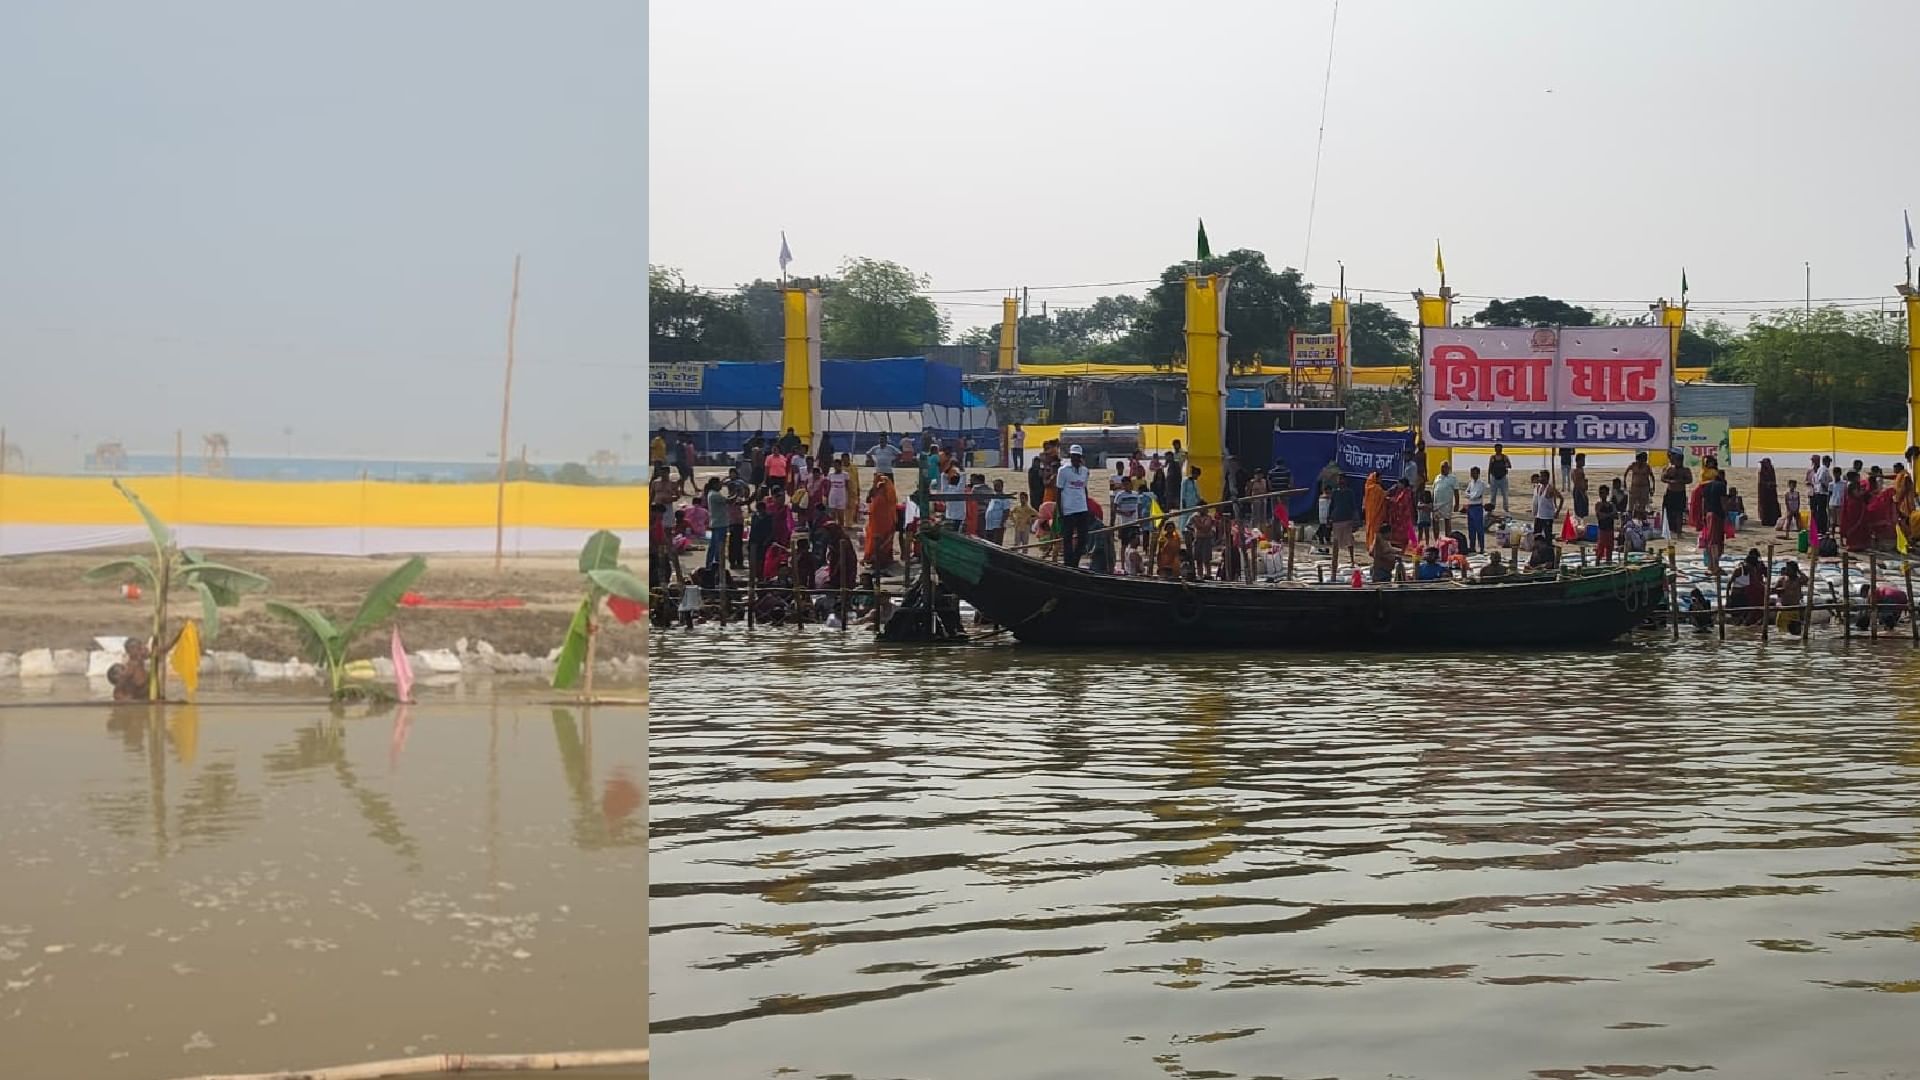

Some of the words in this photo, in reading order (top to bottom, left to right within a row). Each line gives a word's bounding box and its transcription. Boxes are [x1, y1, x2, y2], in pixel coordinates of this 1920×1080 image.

[1430, 345, 1552, 401] शिवा
[1566, 358, 1662, 401] घाट
[1437, 418, 1504, 439] पटना
[1511, 419, 1568, 439] नगर
[1575, 415, 1649, 439] निगम
